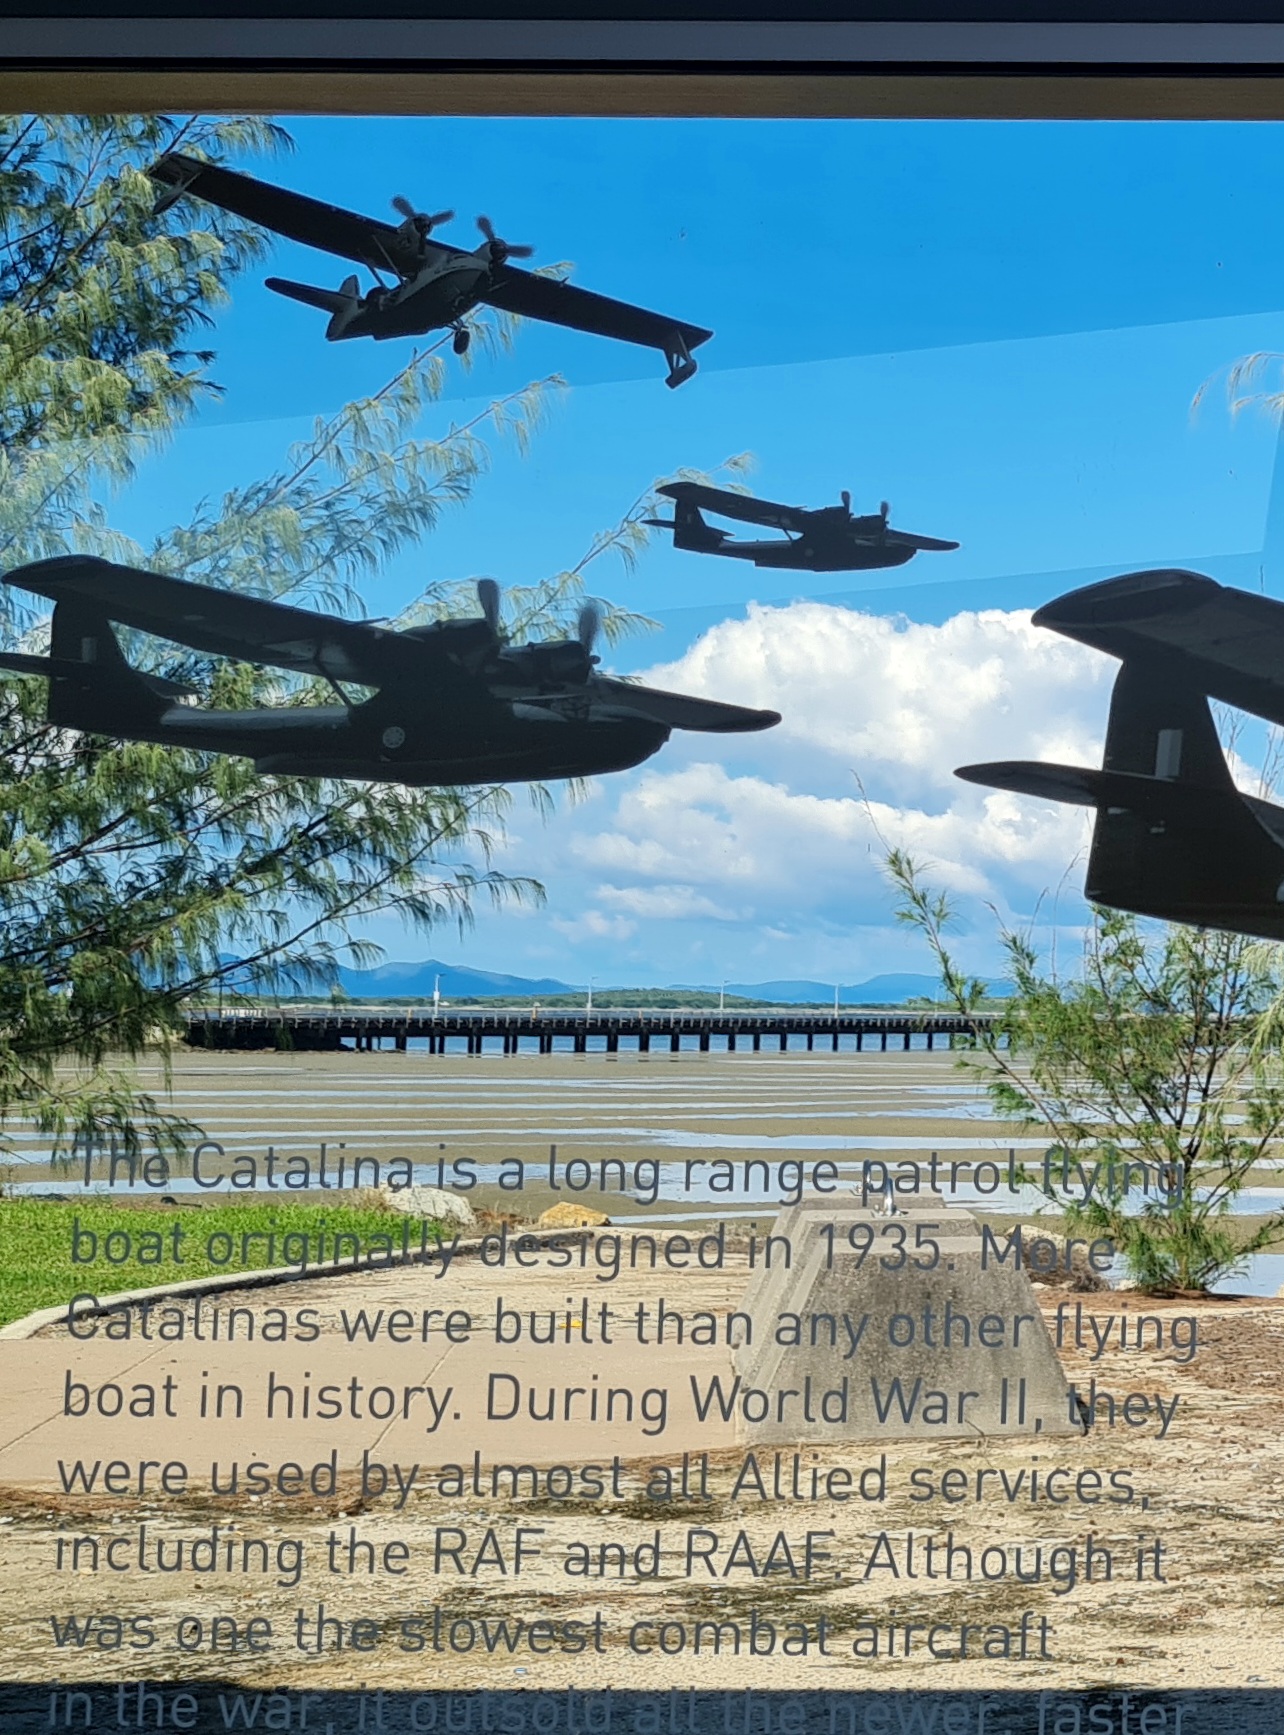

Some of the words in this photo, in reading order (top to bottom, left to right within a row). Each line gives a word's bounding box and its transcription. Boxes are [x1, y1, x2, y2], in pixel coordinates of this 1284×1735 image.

[78, 1141, 170, 1189] The
[192, 1141, 413, 1190] Catalina
[438, 1144, 477, 1191] is
[499, 1155, 525, 1191] a
[548, 1144, 661, 1207] long
[685, 1158, 838, 1207] range
[862, 1149, 1020, 1208] patrol
[1040, 1149, 1184, 1209] flying
[72, 1217, 184, 1265] boat
[206, 1218, 459, 1279] originally
[480, 1221, 725, 1281] designed
[749, 1222, 792, 1269] in
[820, 1223, 955, 1271] 1935.
[981, 1225, 1114, 1272] More
[66, 1292, 320, 1342] Catalinas
[340, 1306, 471, 1343] were
[496, 1297, 614, 1345] built
[635, 1297, 752, 1346] than
[776, 1310, 868, 1359] any
[888, 1300, 1035, 1348] other
[1055, 1302, 1198, 1363] flying
[64, 1370, 178, 1418] boat
[200, 1371, 242, 1418] in
[268, 1371, 462, 1432] history.
[488, 1373, 668, 1436] During
[690, 1374, 848, 1423] World
[871, 1377, 979, 1424] War
[999, 1378, 1043, 1434] II,
[1067, 1378, 1180, 1439] they
[57, 1459, 189, 1495] were
[212, 1450, 337, 1496] used
[362, 1450, 419, 1509] by
[440, 1451, 625, 1499] almost
[646, 1453, 713, 1501] all
[731, 1453, 887, 1502] Allied
[909, 1455, 1150, 1512] services,
[56, 1524, 302, 1587] including
[326, 1527, 410, 1575] the
[434, 1527, 544, 1576] RAF
[563, 1530, 661, 1578] and
[686, 1530, 841, 1579] RAAF.
[865, 1531, 1113, 1595] Although
[1133, 1535, 1166, 1583] it
[50, 1613, 156, 1649] was
[178, 1616, 272, 1651] one
[295, 1604, 378, 1652] the
[400, 1606, 607, 1654] slowest
[629, 1610, 830, 1657] combat
[851, 1610, 1054, 1659] aircraft
[51, 1678, 91, 1726] in
[117, 1681, 199, 1728] the
[358, 1682, 390, 1730] it
[411, 1684, 612, 1733] outsold
[634, 1685, 701, 1734] all
[724, 1687, 805, 1735] the
[1037, 1690, 1197, 1735] faster
